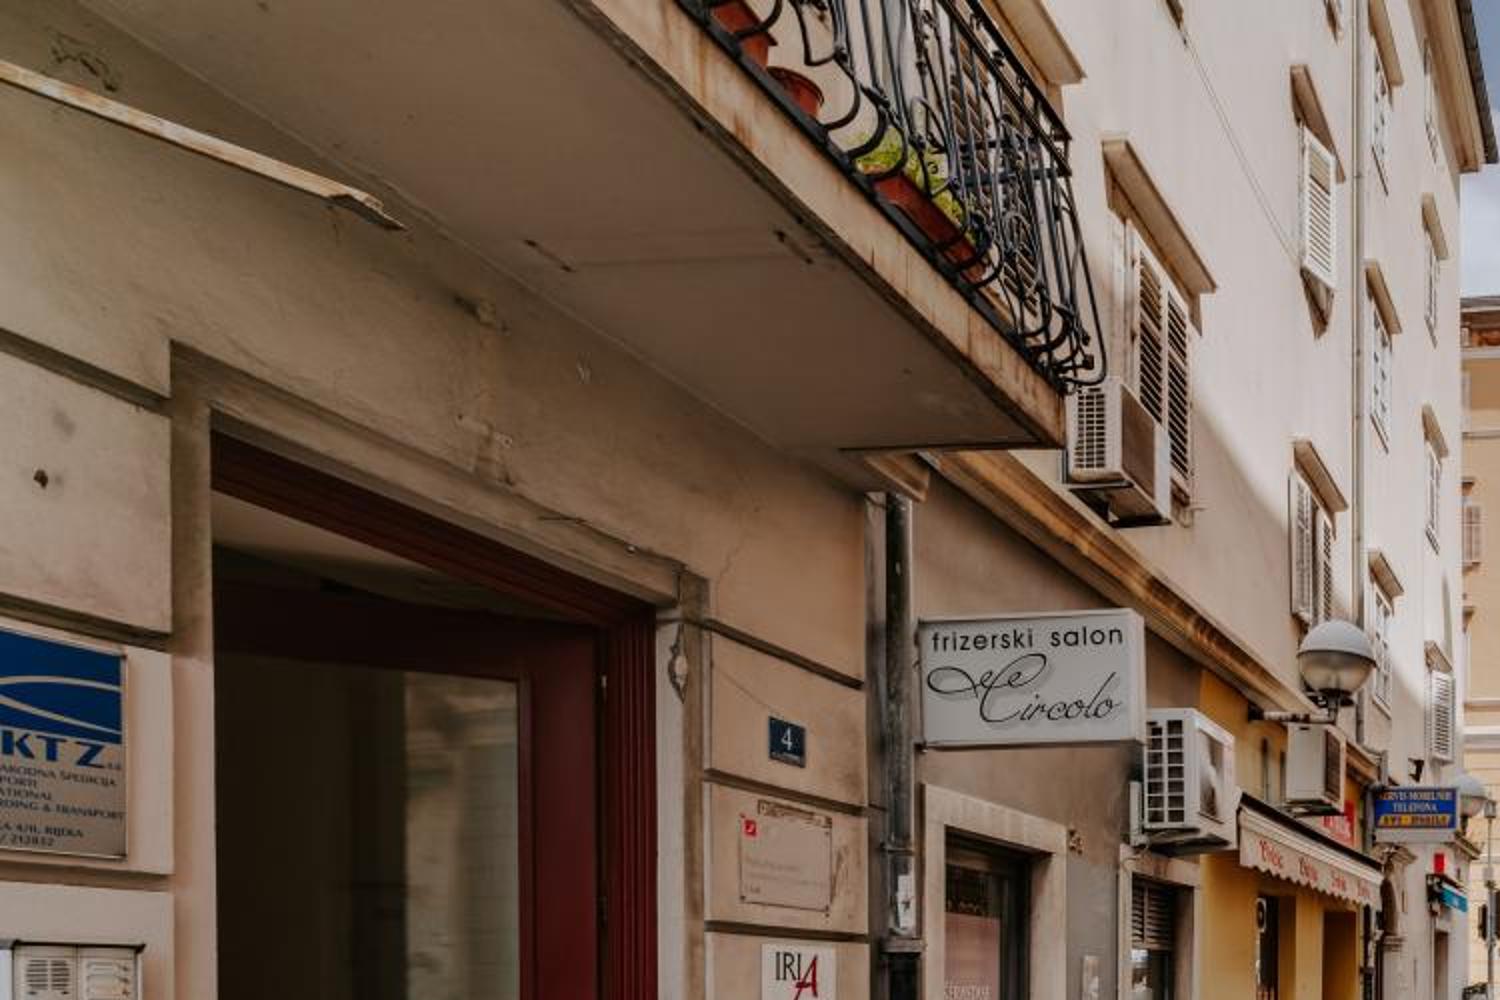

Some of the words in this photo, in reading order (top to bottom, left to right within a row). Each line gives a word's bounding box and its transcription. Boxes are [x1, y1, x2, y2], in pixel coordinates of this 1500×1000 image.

[931, 627, 1034, 651] frizerski
[1049, 626, 1124, 648] salon
[1, 729, 105, 769] KTZ
[780, 727, 793, 751] 4
